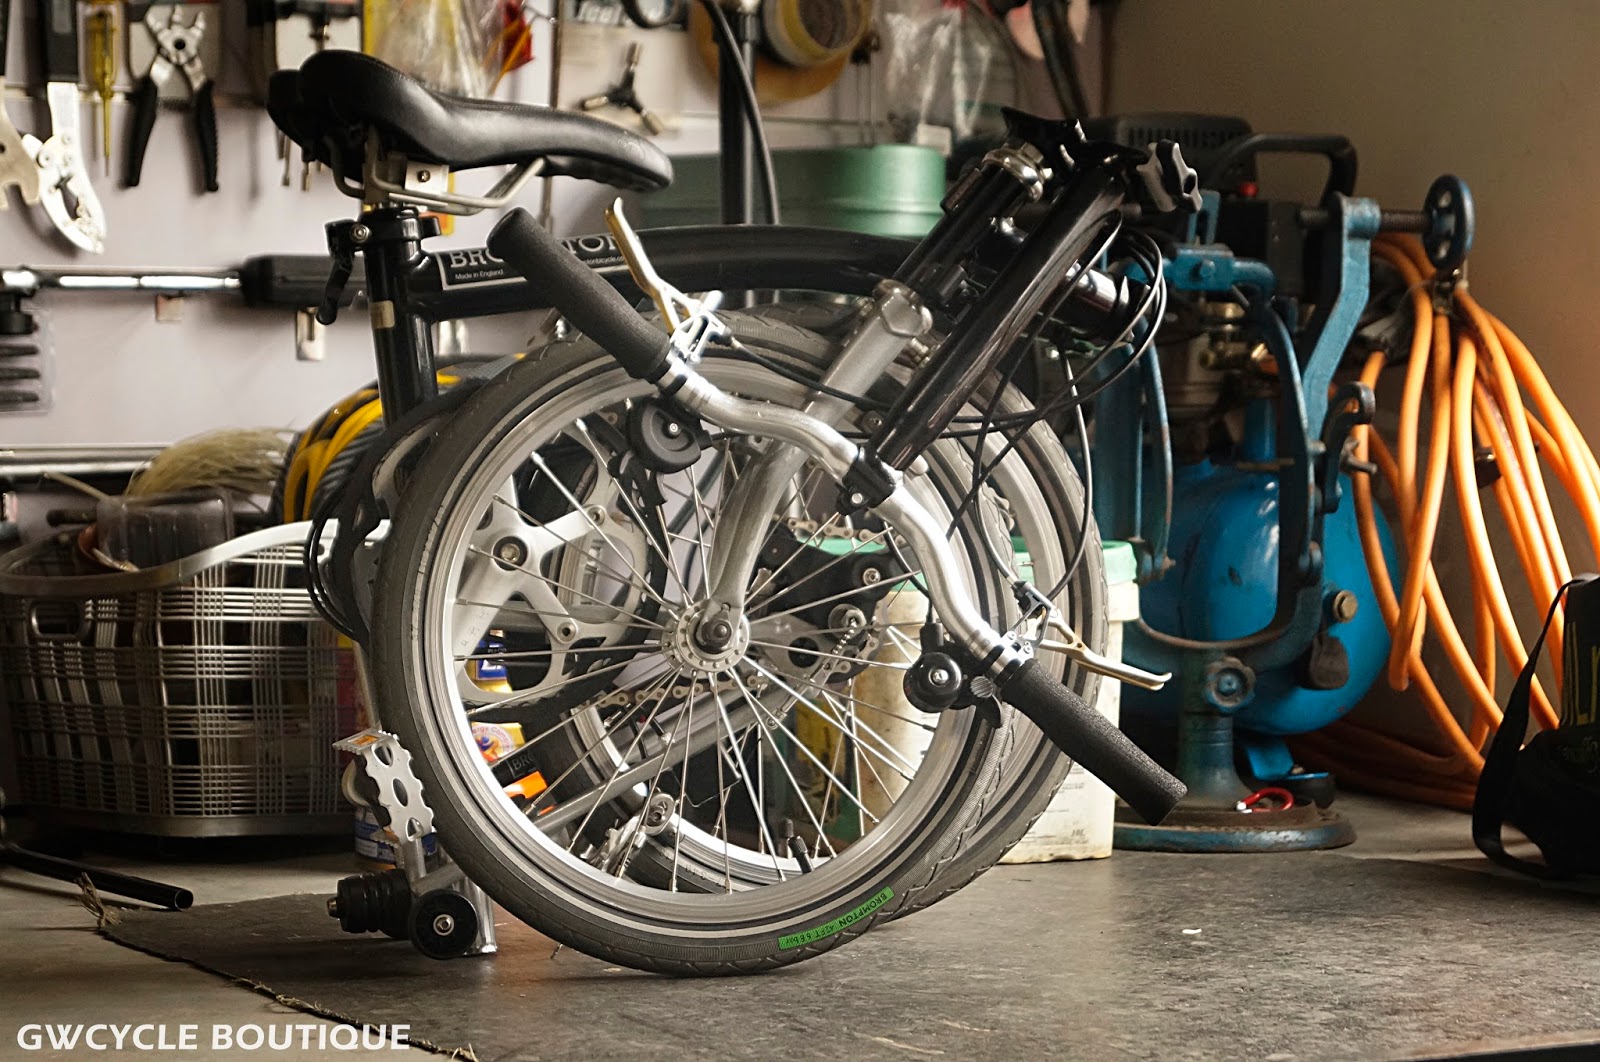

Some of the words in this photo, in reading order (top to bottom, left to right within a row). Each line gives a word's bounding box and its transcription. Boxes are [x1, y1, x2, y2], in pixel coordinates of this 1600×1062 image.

[455, 272, 473, 280] Made
[480, 269, 504, 278] England
[838, 892, 888, 927] BROMPTON
